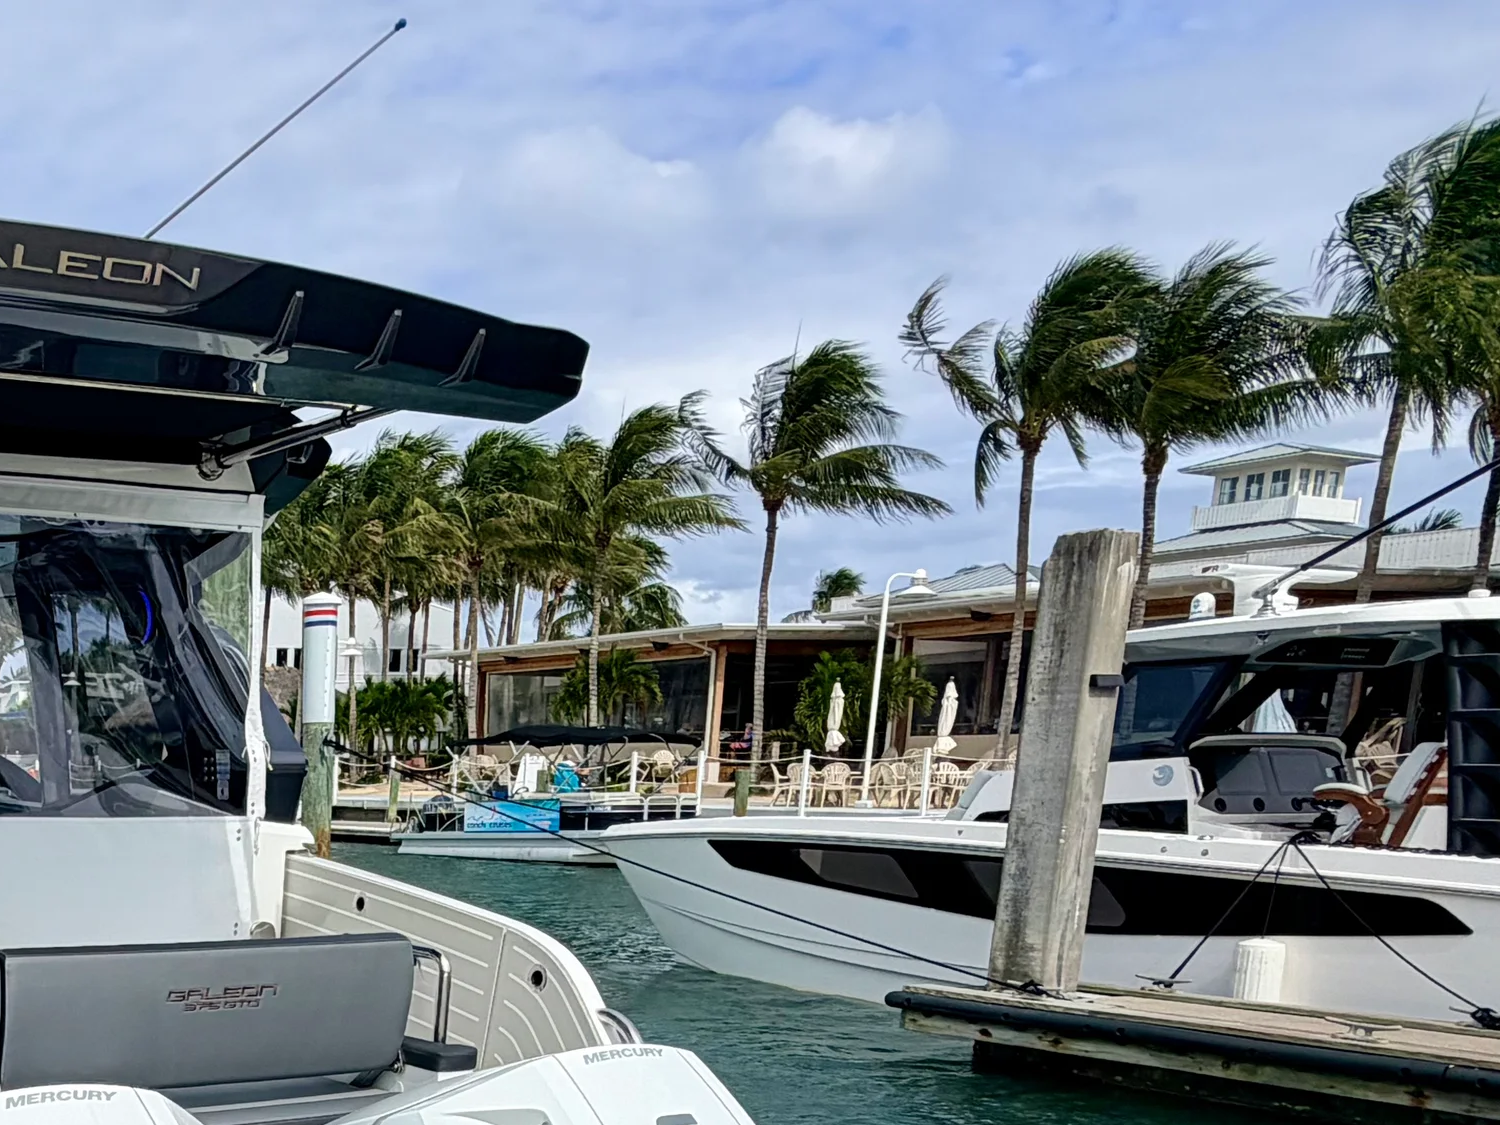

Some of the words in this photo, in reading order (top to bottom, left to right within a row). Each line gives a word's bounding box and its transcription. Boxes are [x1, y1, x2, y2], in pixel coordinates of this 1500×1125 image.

[166, 984, 278, 1003] GALEON
[583, 1047, 663, 1065] MERCURY
[5, 1090, 117, 1110] MERCURY
